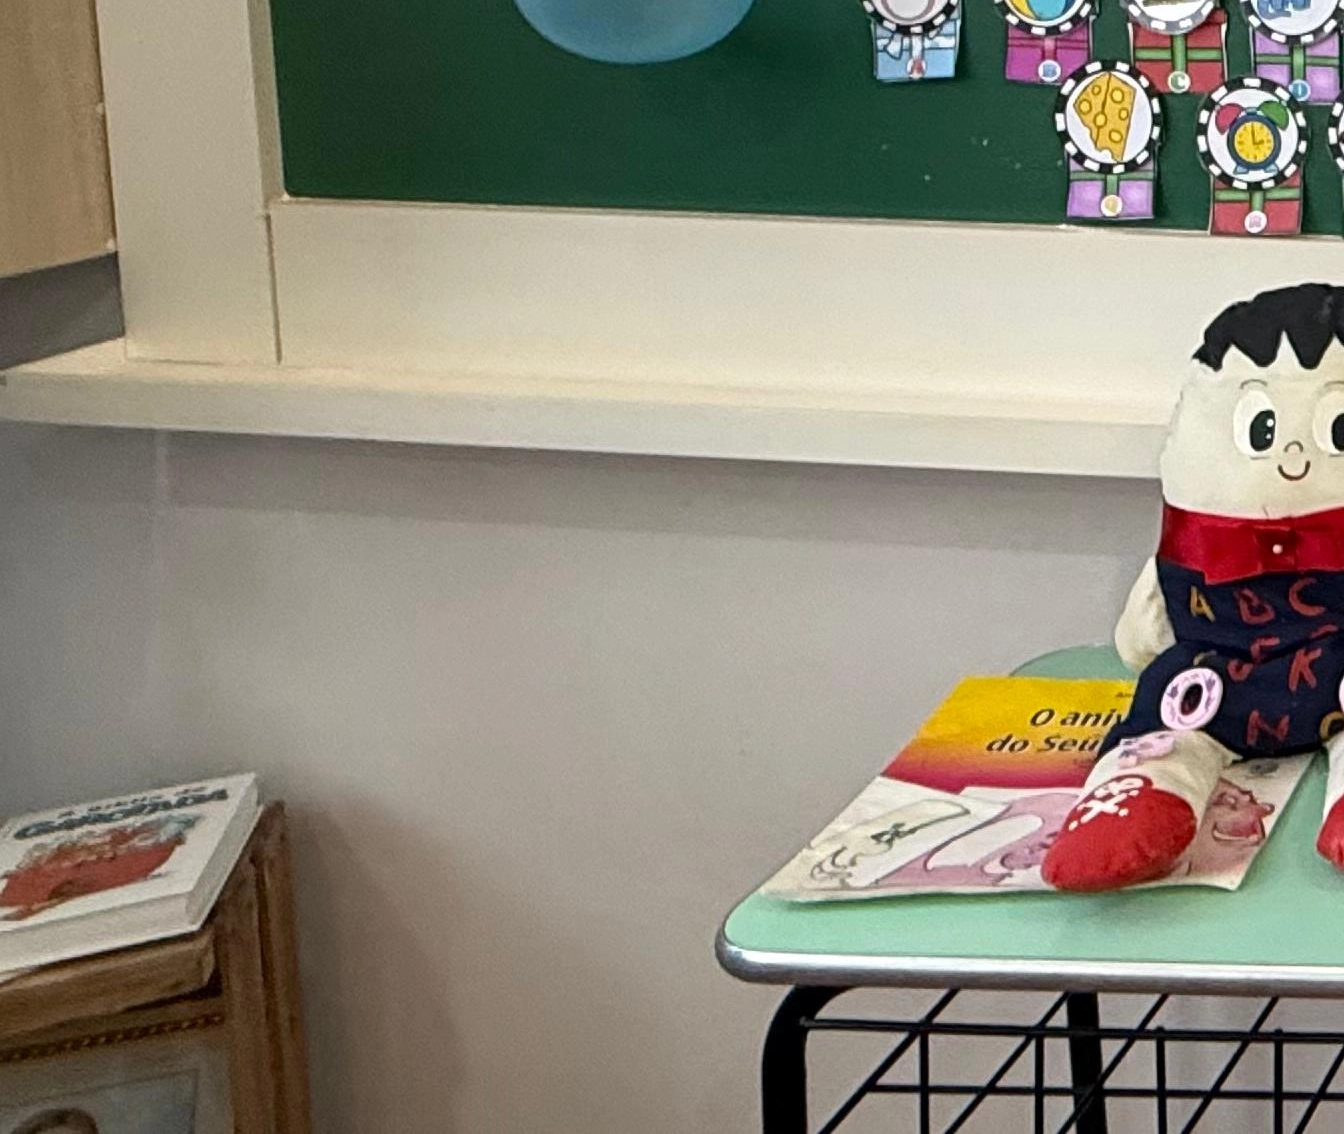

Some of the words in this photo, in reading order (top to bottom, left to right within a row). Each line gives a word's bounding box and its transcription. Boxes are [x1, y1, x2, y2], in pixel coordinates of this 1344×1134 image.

[1288, 577, 1327, 617] C
[1288, 647, 1323, 692] K
[1030, 708, 1056, 727] O
[1246, 709, 1291, 747] N
[986, 733, 1030, 752] do
[1037, 734, 1099, 752] Seu
